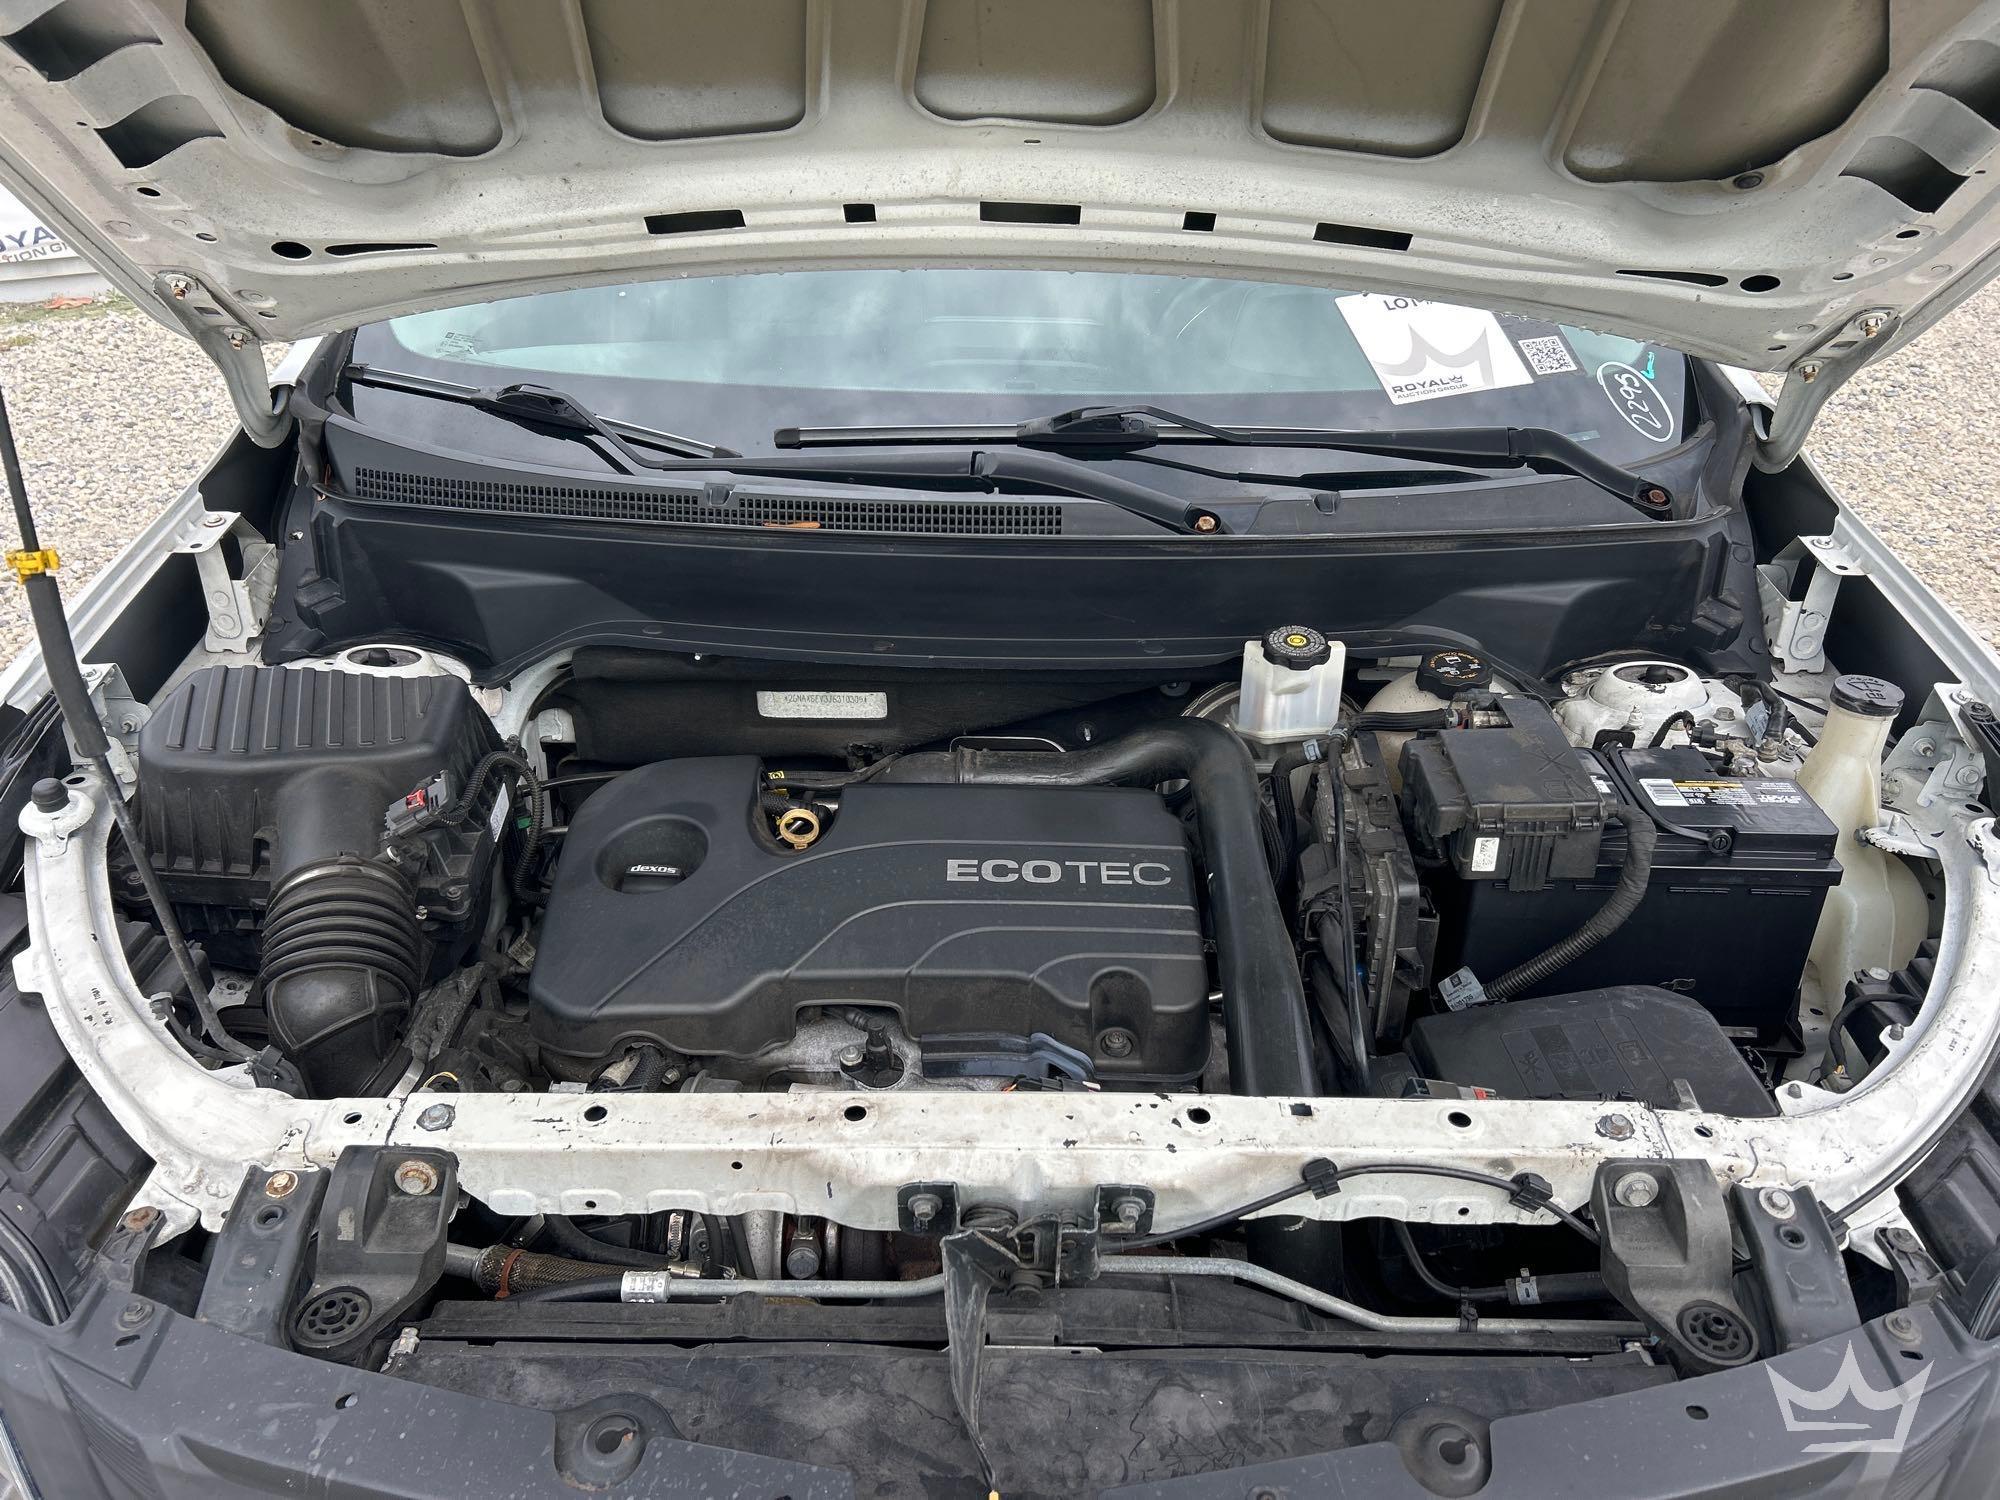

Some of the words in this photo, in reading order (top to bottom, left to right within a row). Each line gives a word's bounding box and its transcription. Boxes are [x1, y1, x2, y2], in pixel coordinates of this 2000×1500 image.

[1392, 378, 1450, 394] ROYAL
[1397, 389, 1437, 399] AUCTION
[1437, 383, 1469, 393] GROUP
[1614, 373, 1662, 429] 2295
[630, 864, 679, 874] dexos
[946, 859, 1172, 886] ECOTEC
